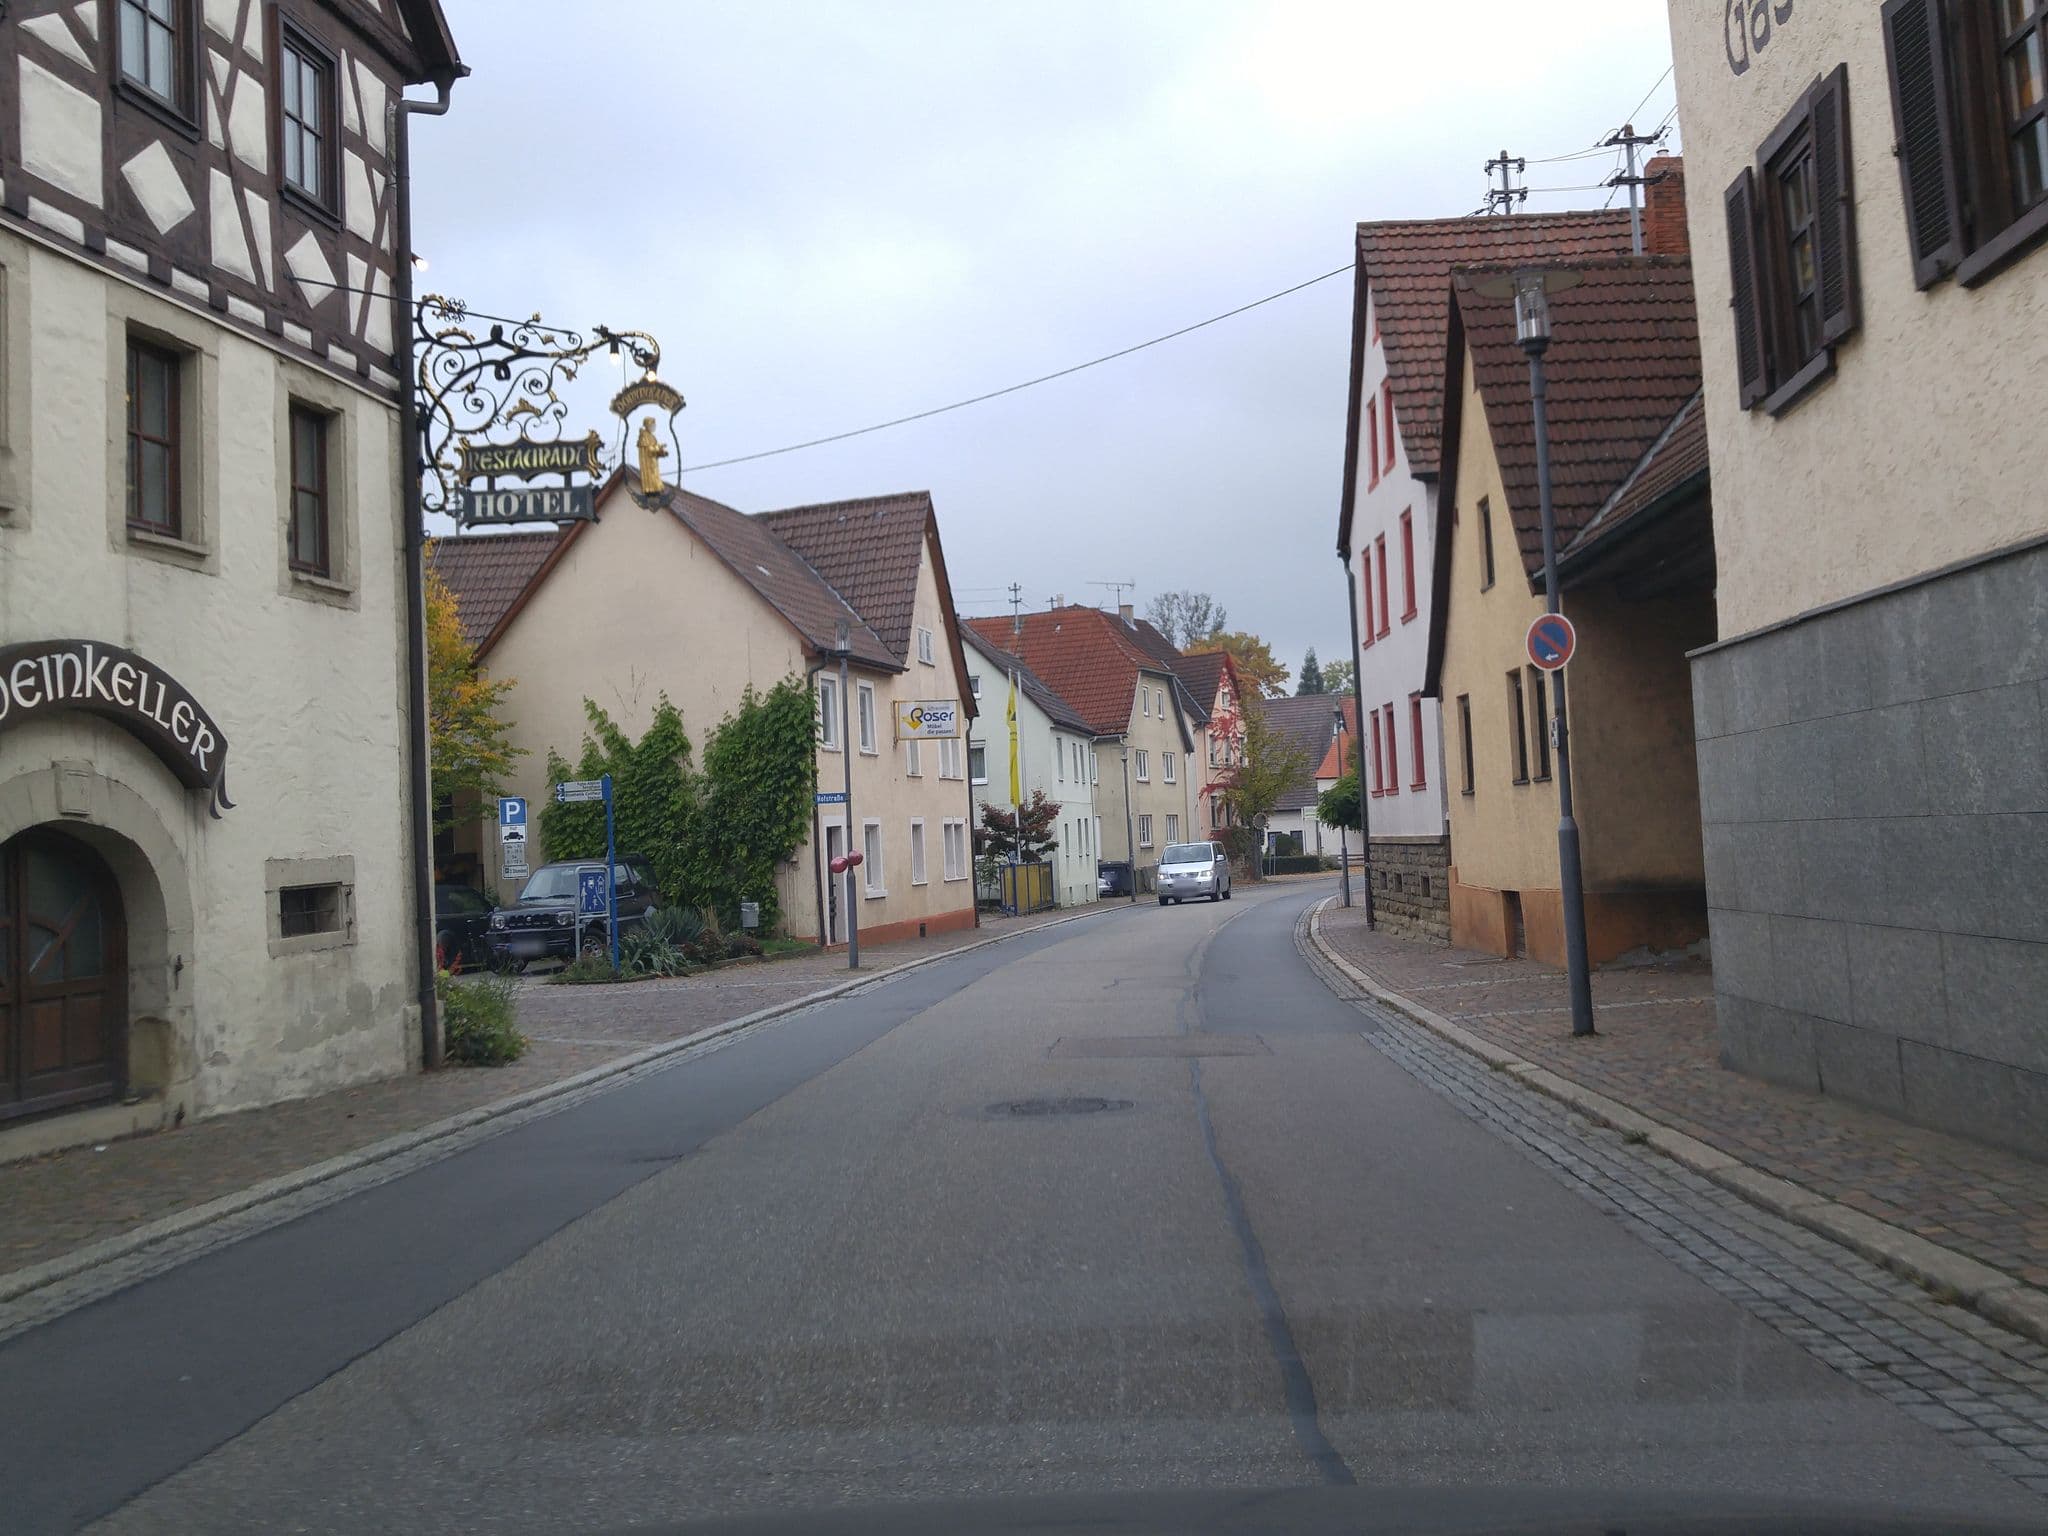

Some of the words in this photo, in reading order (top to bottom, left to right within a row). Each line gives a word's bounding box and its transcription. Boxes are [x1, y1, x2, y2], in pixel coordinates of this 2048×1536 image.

[474, 490, 580, 518] HOTEL
[910, 707, 954, 724] Roser
[505, 801, 520, 823] P
